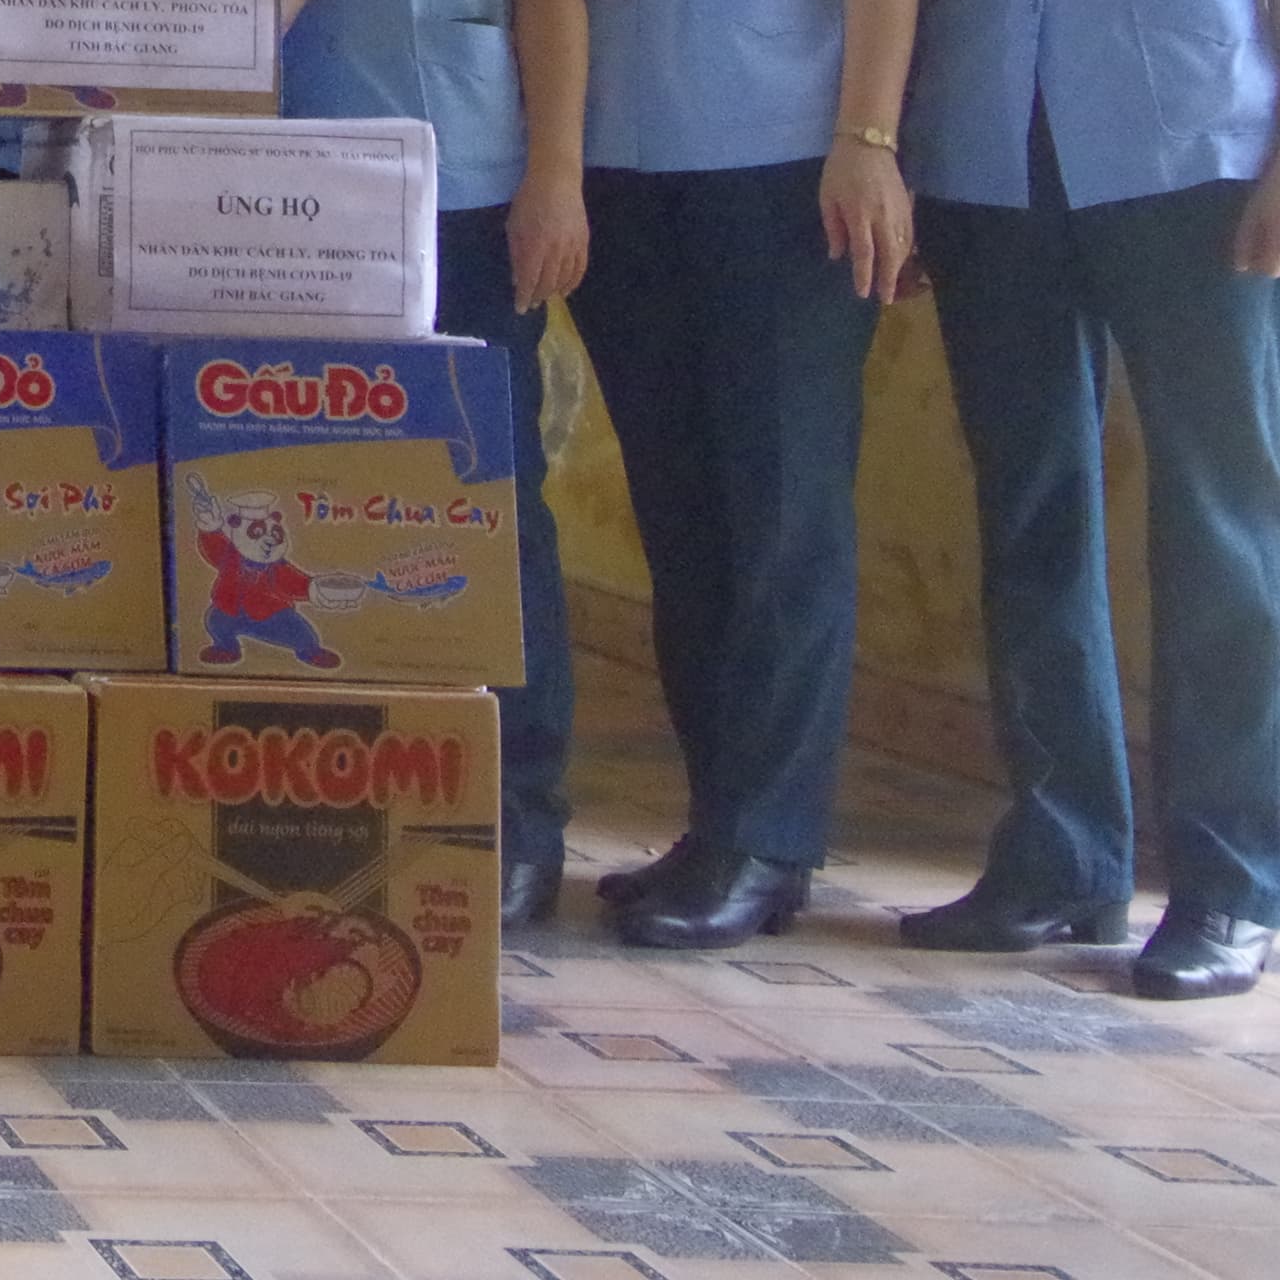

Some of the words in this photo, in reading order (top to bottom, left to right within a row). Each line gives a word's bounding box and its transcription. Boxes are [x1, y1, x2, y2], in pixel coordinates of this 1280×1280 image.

[216, 188, 273, 216] ỦNG
[281, 193, 320, 221] HỘ
[297, 492, 354, 521] Tôm
[364, 495, 436, 525] Chua
[446, 498, 499, 533] Cay
[152, 726, 467, 808] KOKOMI
